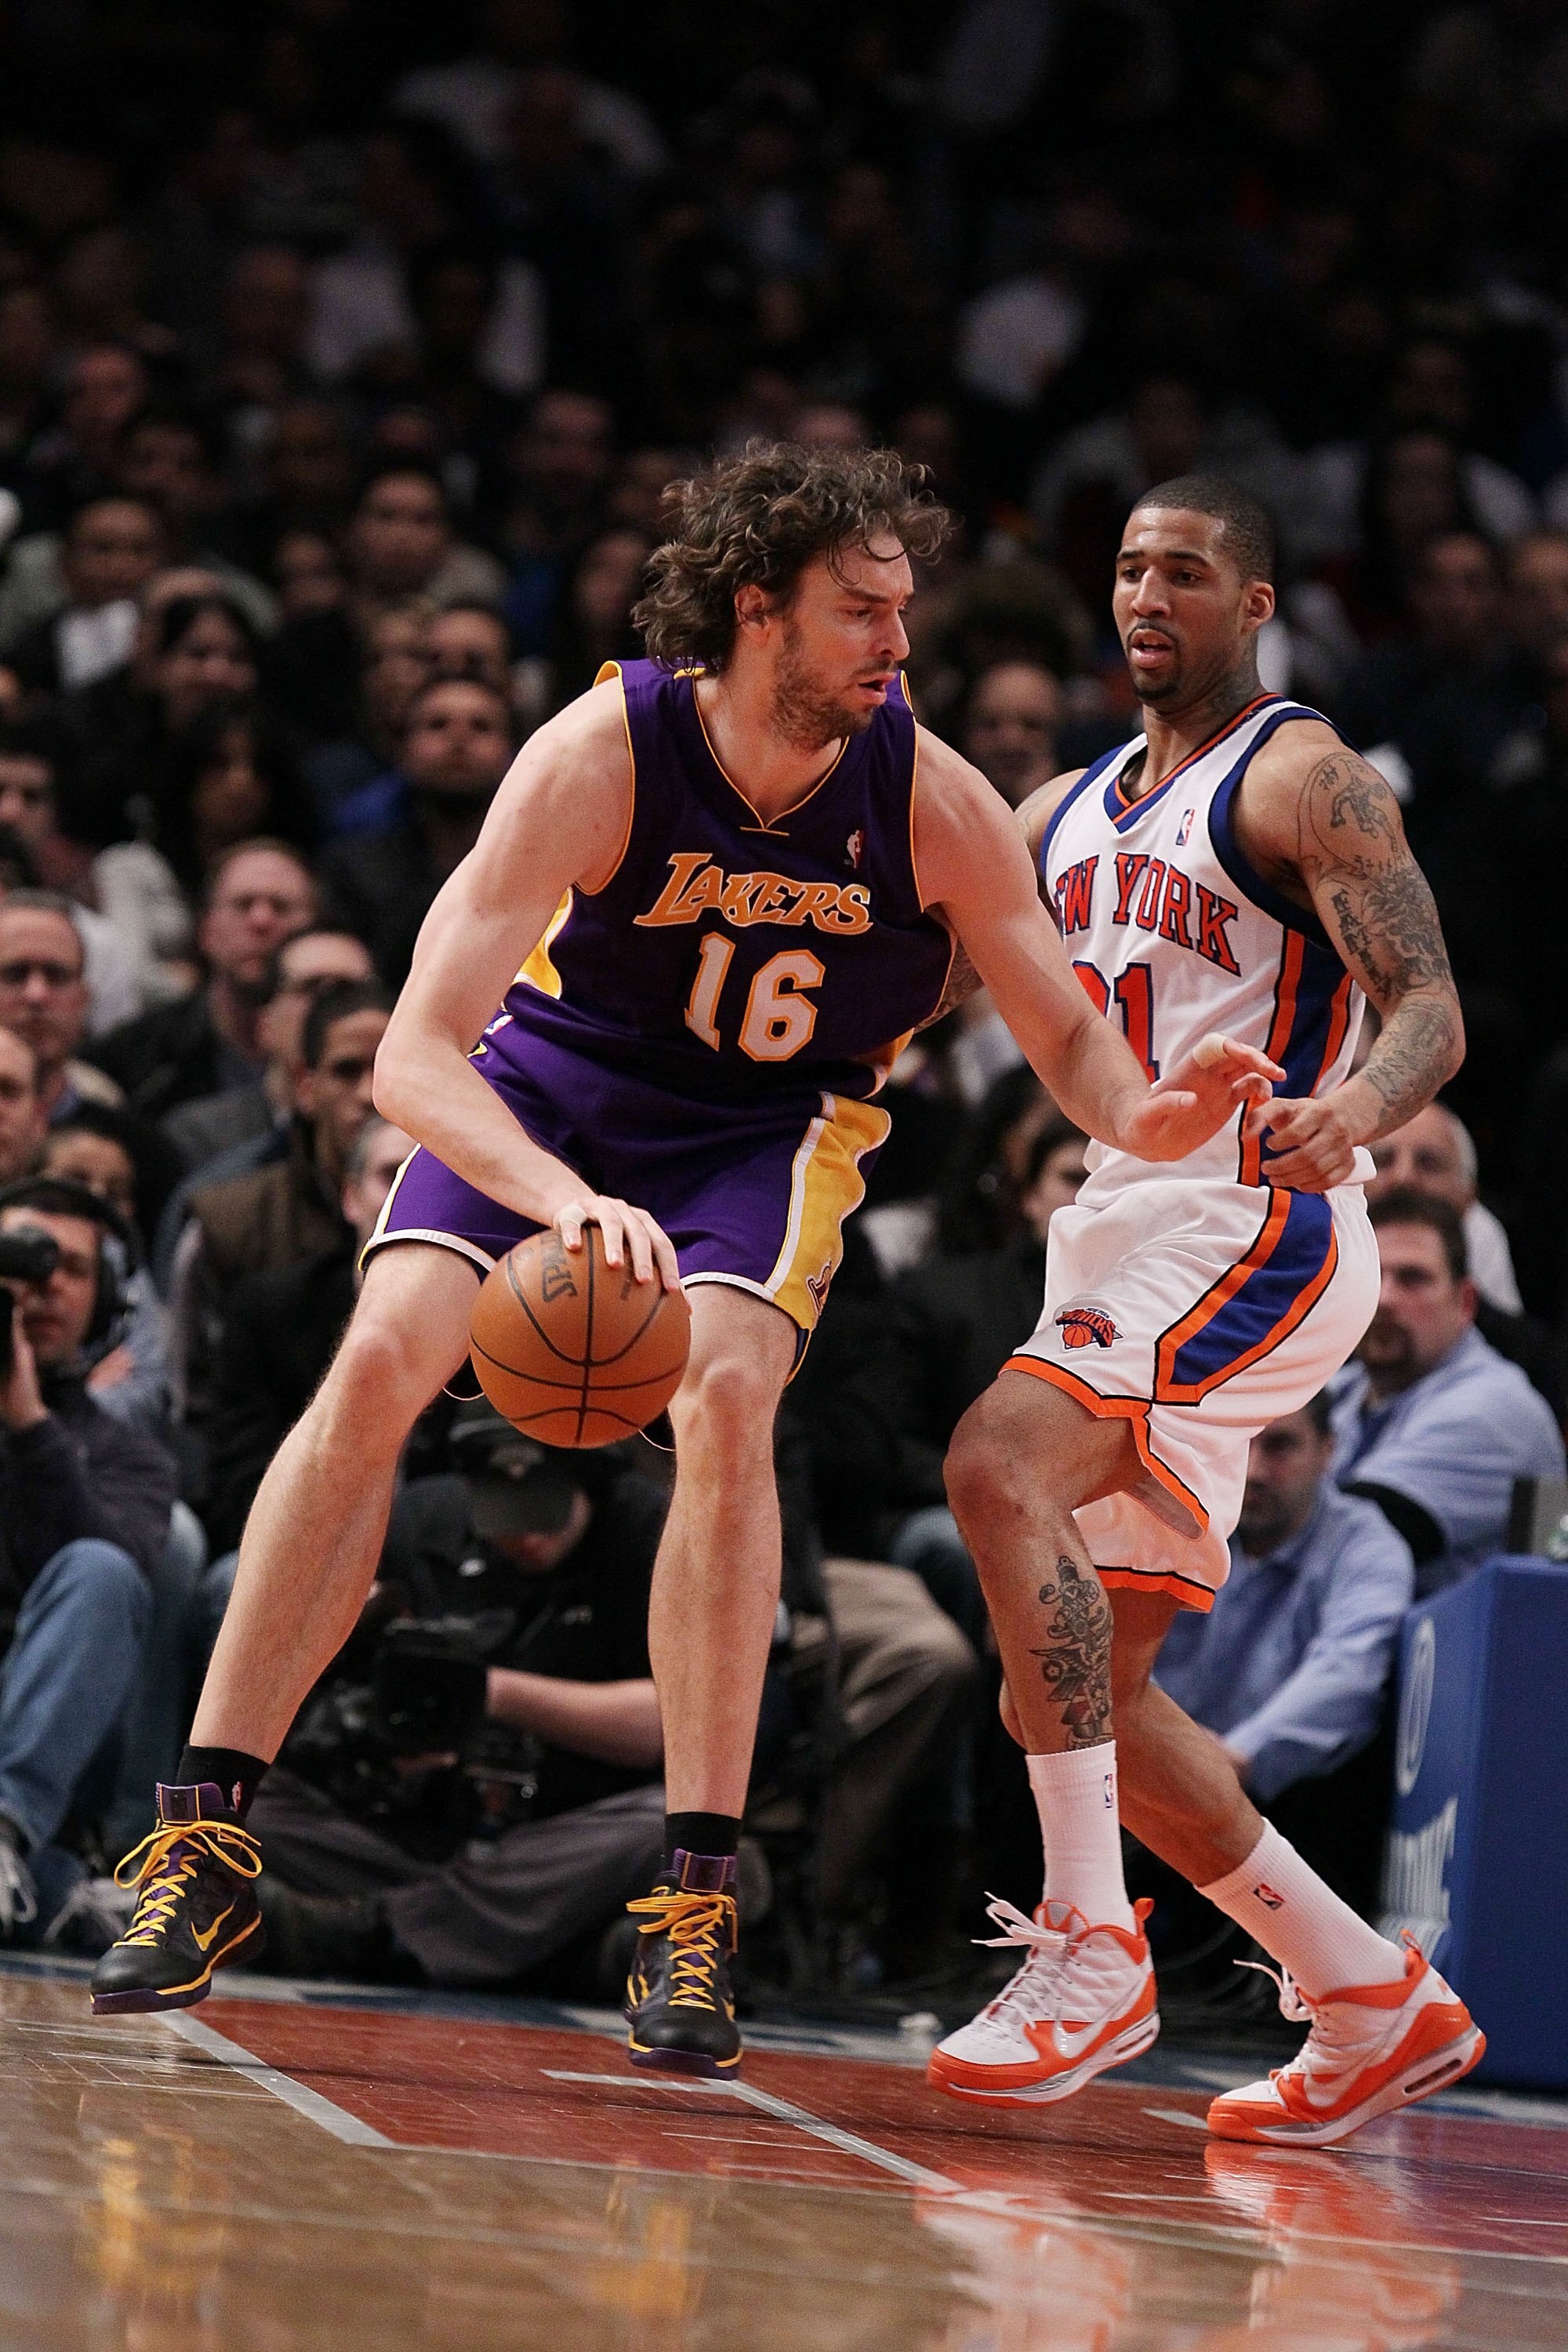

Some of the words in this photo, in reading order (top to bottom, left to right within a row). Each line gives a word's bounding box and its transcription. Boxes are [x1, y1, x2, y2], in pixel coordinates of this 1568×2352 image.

[633, 853, 873, 935] LAKERS
[1054, 855, 1099, 935] EW
[1112, 852, 1242, 977] YORK
[684, 931, 826, 1062] 16
[1072, 960, 1160, 1087] 1
